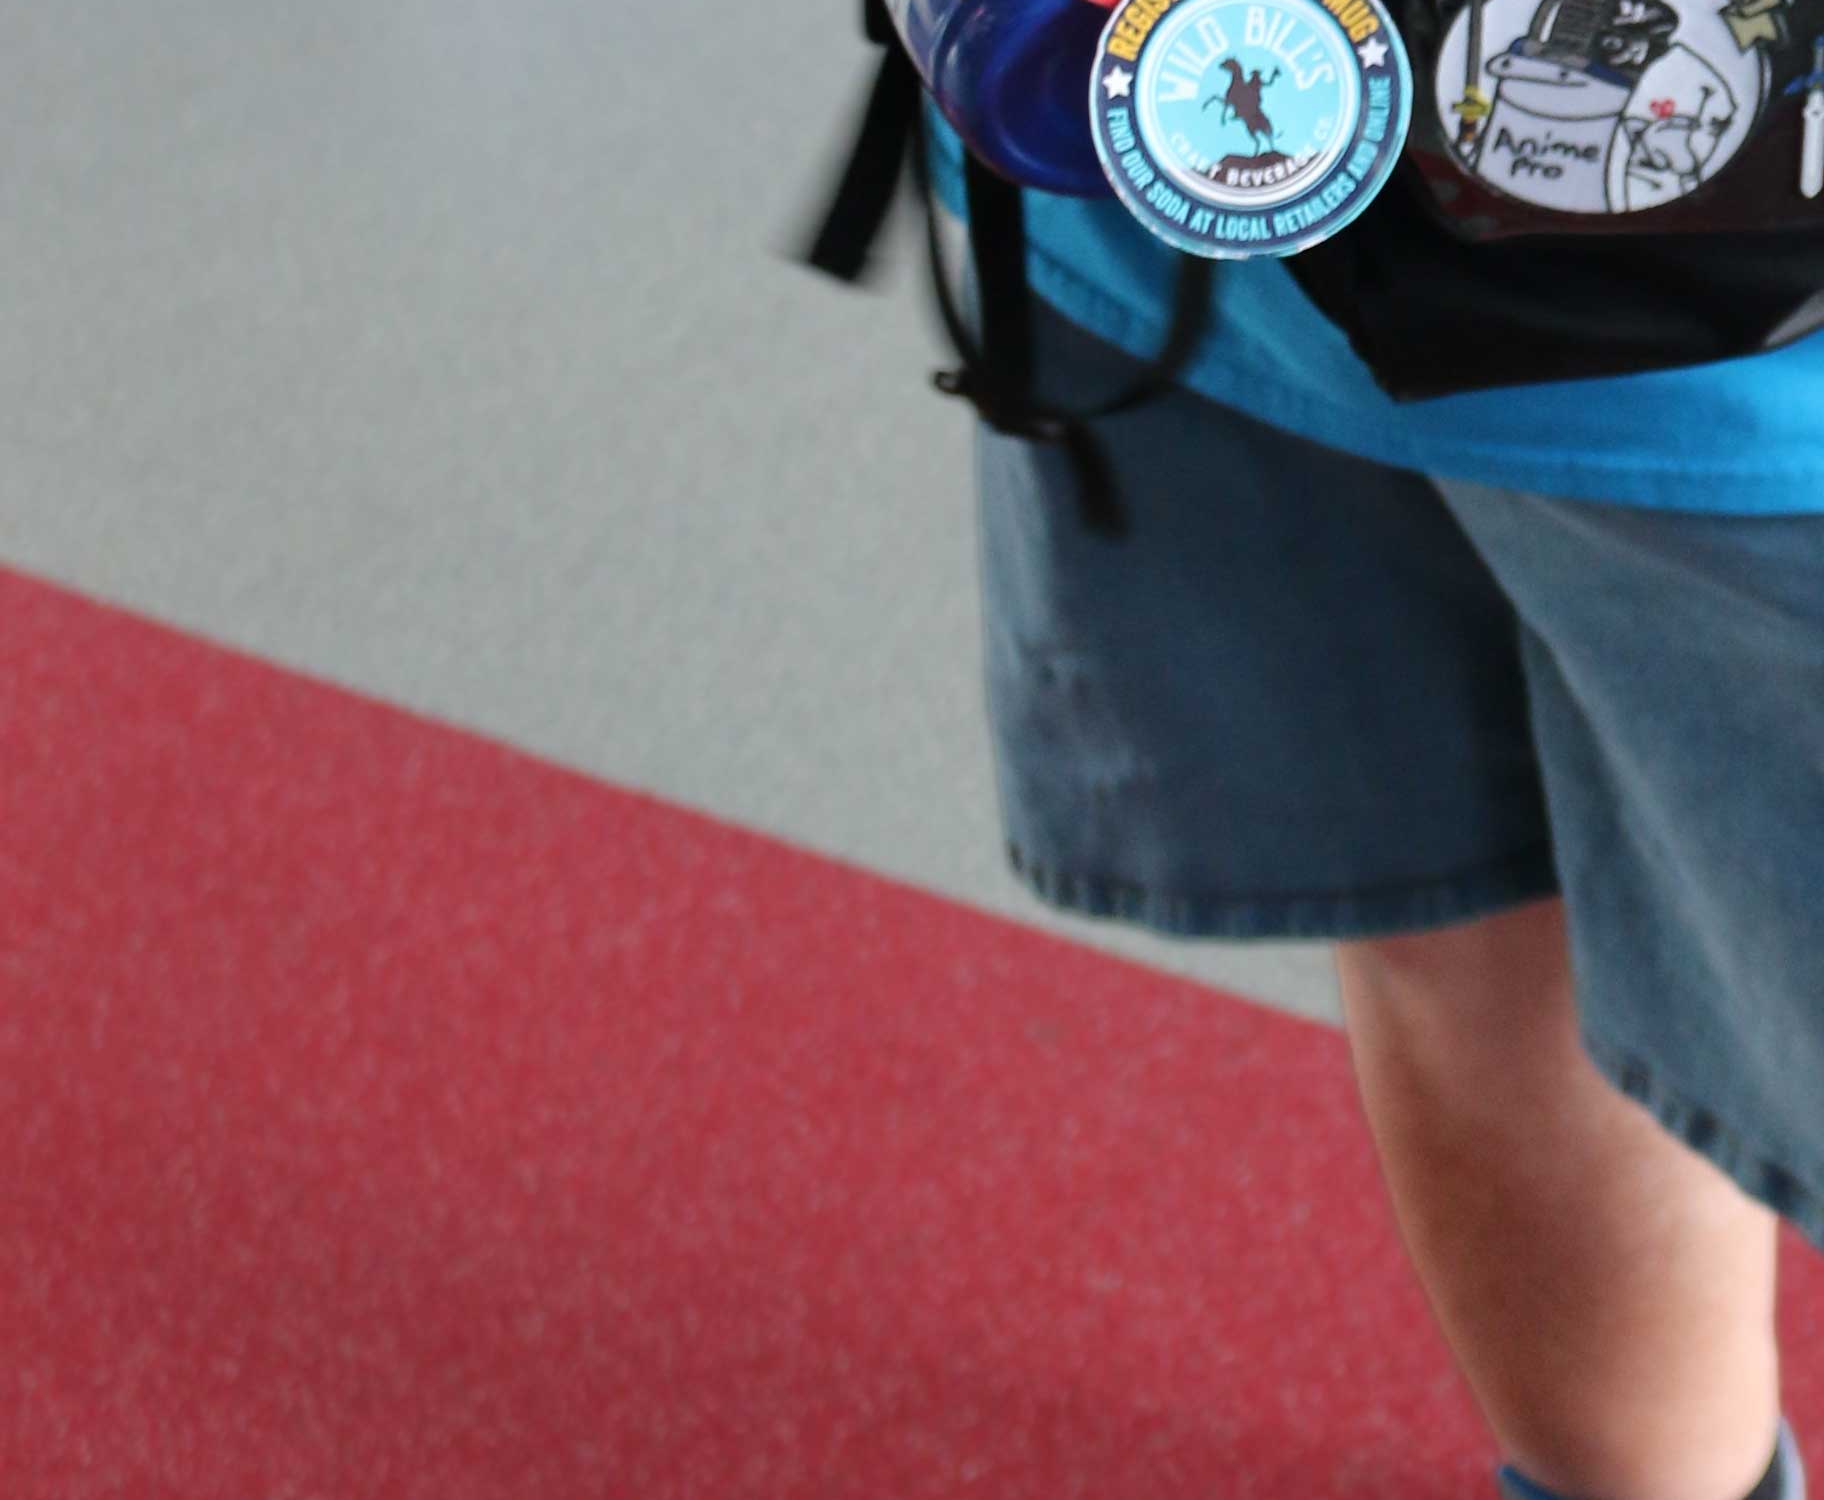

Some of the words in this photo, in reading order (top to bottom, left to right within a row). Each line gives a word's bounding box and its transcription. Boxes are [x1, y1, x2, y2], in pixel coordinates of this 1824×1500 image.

[1157, 14, 1230, 102] WILD
[1244, 4, 1335, 91] BILL'S
[1106, 106, 1136, 155] FIND
[1363, 74, 1392, 143] ONLINE
[1120, 149, 1156, 192] OUR
[1145, 179, 1191, 225] SODA
[1188, 207, 1216, 235] AT
[1272, 170, 1357, 238] RETAILERS
[1214, 213, 1271, 242] LOCAL
